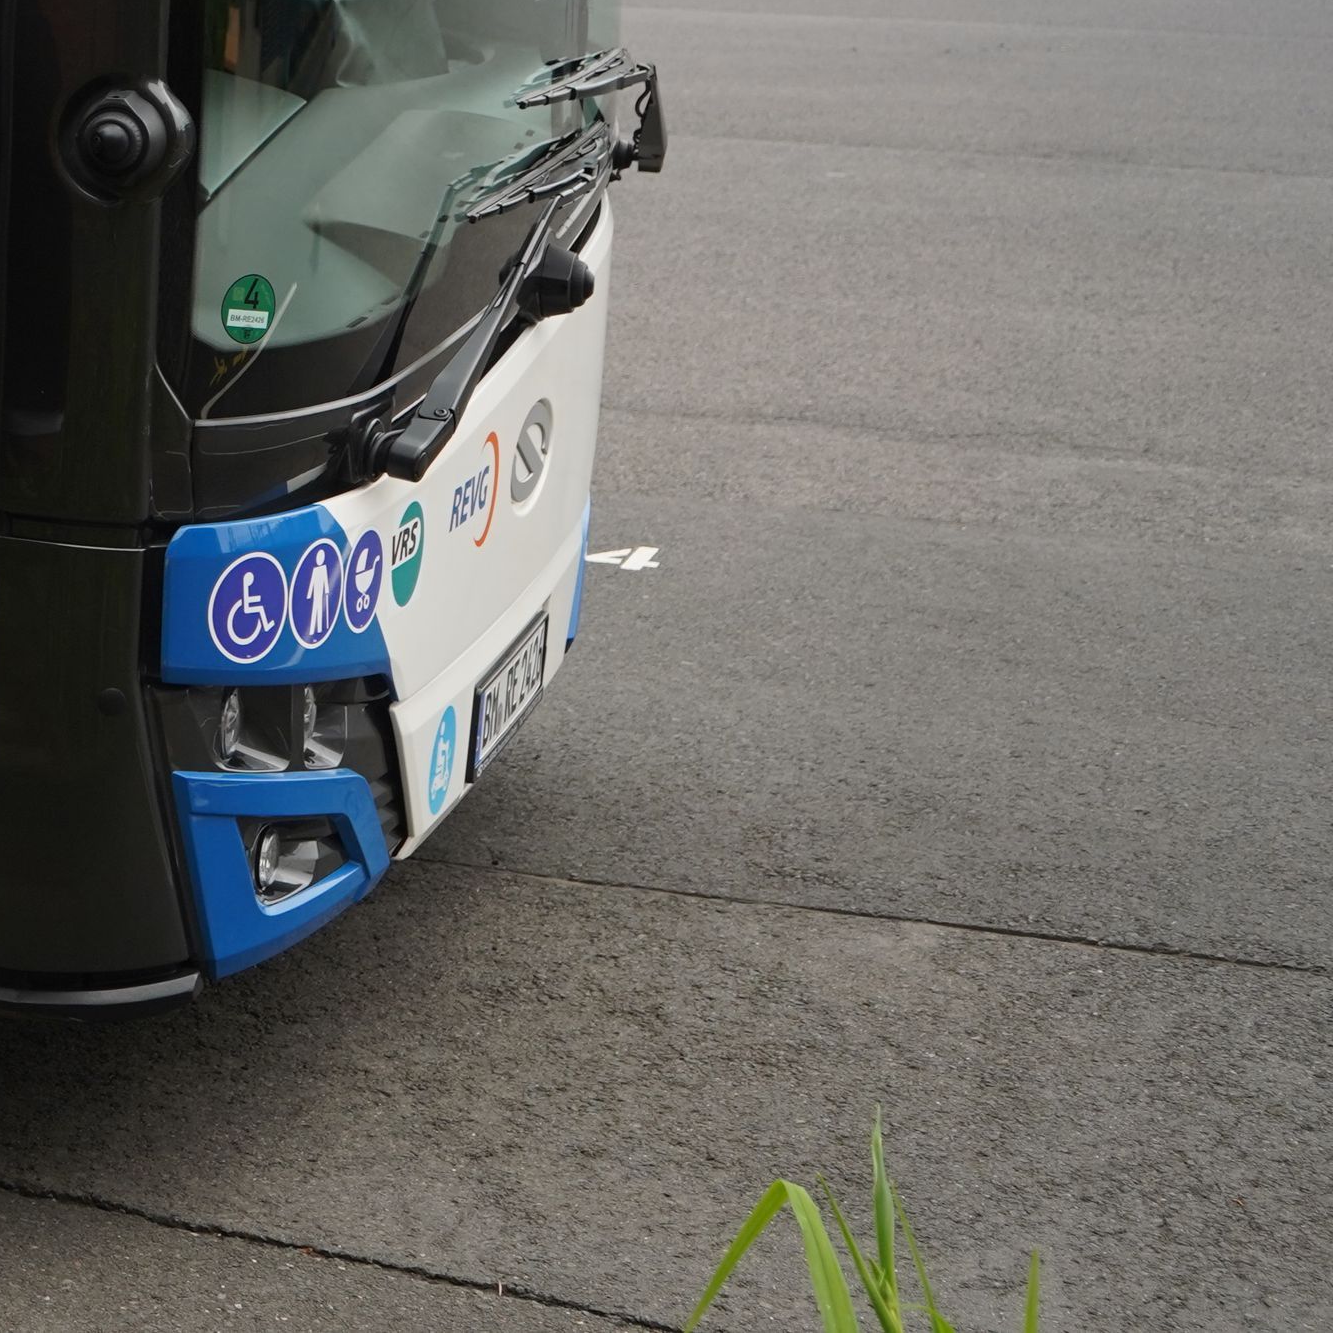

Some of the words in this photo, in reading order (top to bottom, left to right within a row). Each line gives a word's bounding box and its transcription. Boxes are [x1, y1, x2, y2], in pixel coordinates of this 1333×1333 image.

[244, 277, 260, 309] 4
[230, 313, 265, 324] BM-RE2426
[448, 465, 490, 533] REVG
[391, 520, 419, 567] VRS
